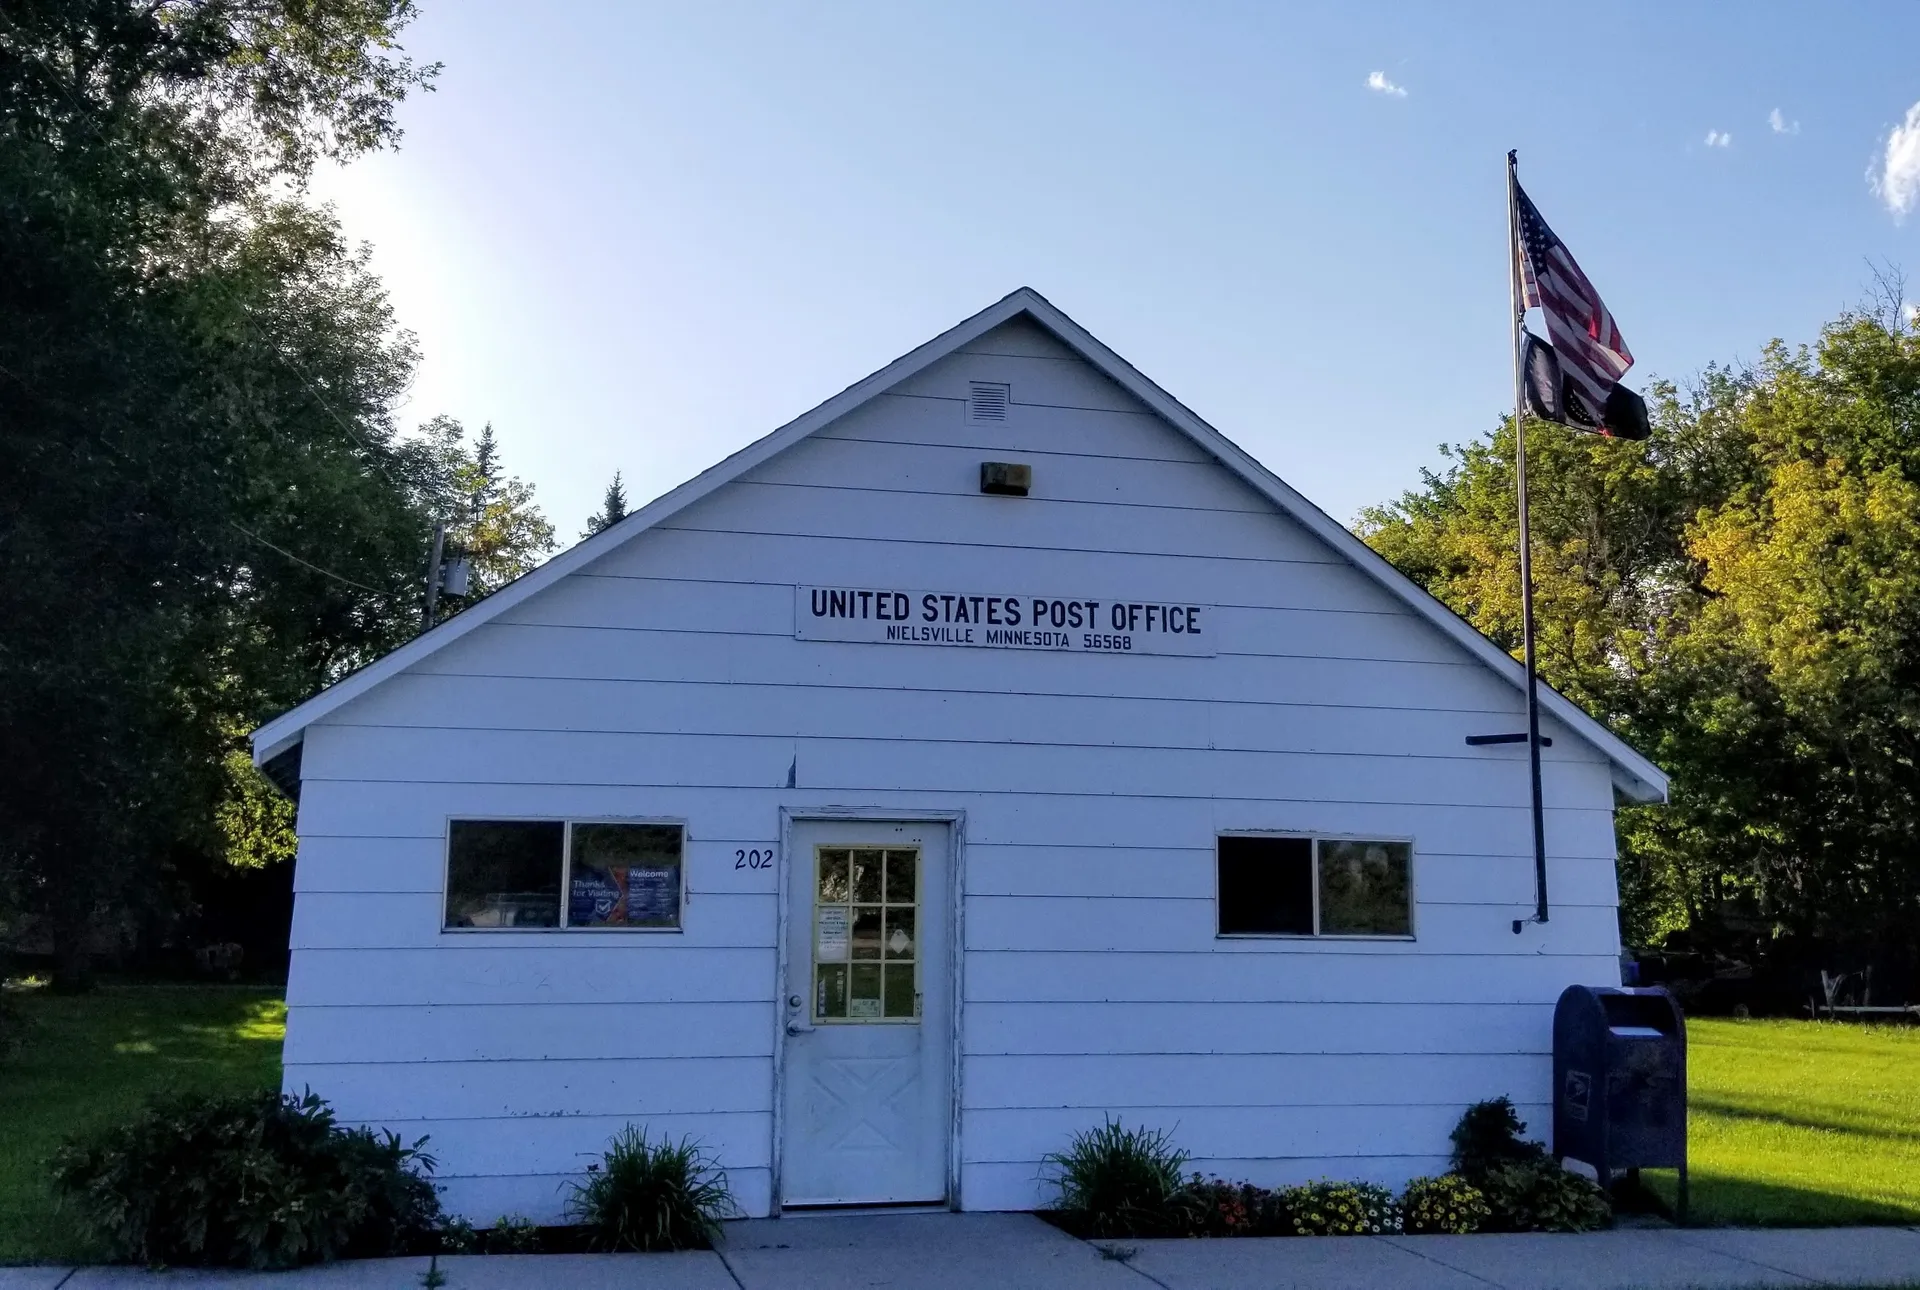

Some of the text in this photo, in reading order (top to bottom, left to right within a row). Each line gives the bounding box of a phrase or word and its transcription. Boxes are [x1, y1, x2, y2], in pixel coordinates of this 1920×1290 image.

[812, 589, 1201, 634] UNITED STATES POST OFFICE
[886, 625, 1131, 650] NIELSVILLE MINNESOTA 56568
[735, 849, 773, 870] 202
[574, 880, 605, 888] Thanks
[630, 870, 668, 878] Welcome
